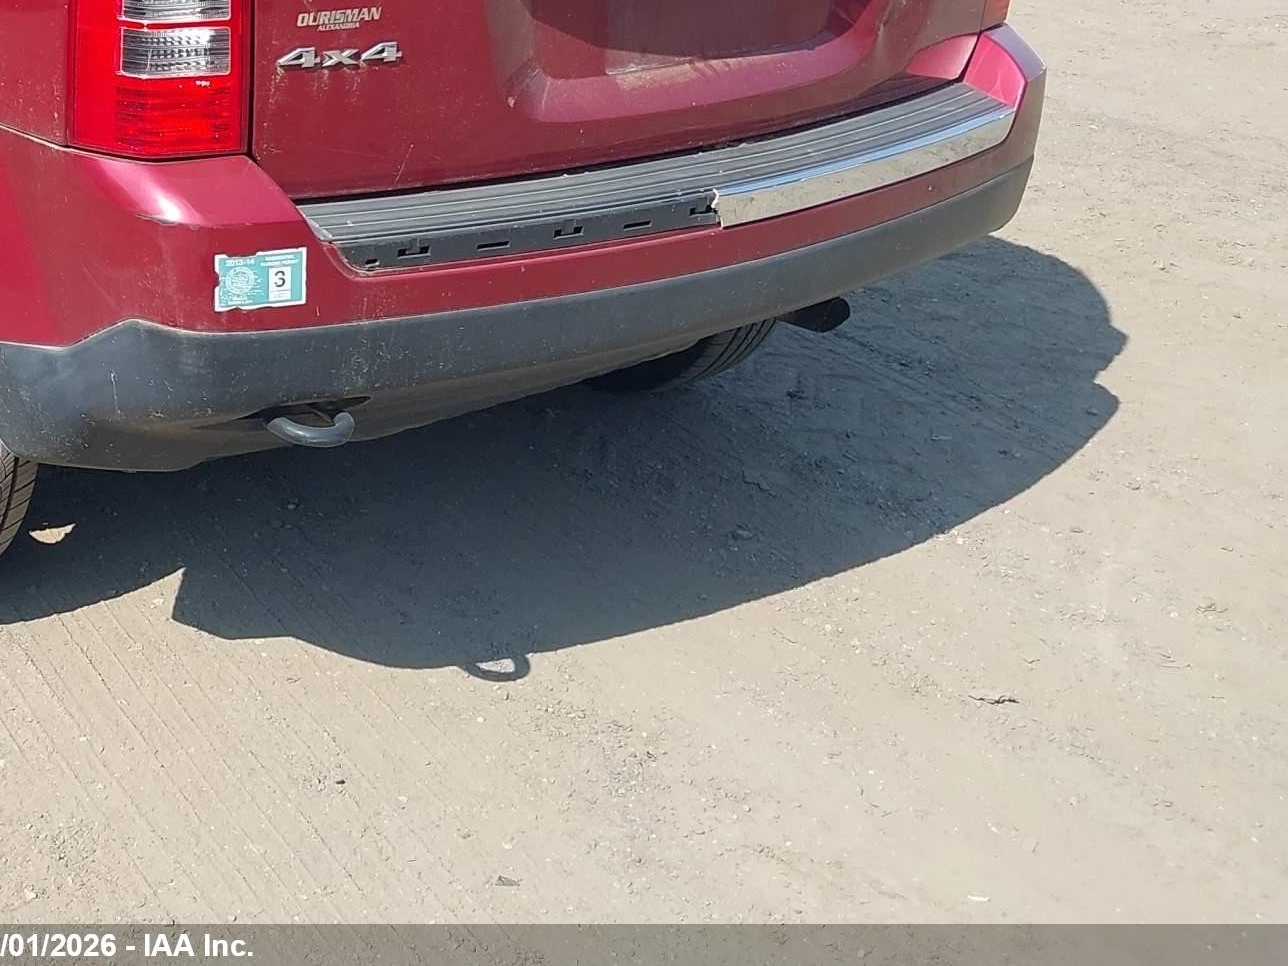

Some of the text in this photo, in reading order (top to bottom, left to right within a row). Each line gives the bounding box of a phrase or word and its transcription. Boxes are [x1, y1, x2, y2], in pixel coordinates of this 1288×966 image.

[297, 6, 382, 27] OURISMAN
[317, 22, 360, 32] ALEXANDRIA
[277, 41, 403, 68] 4x4
[274, 270, 286, 288] 3
